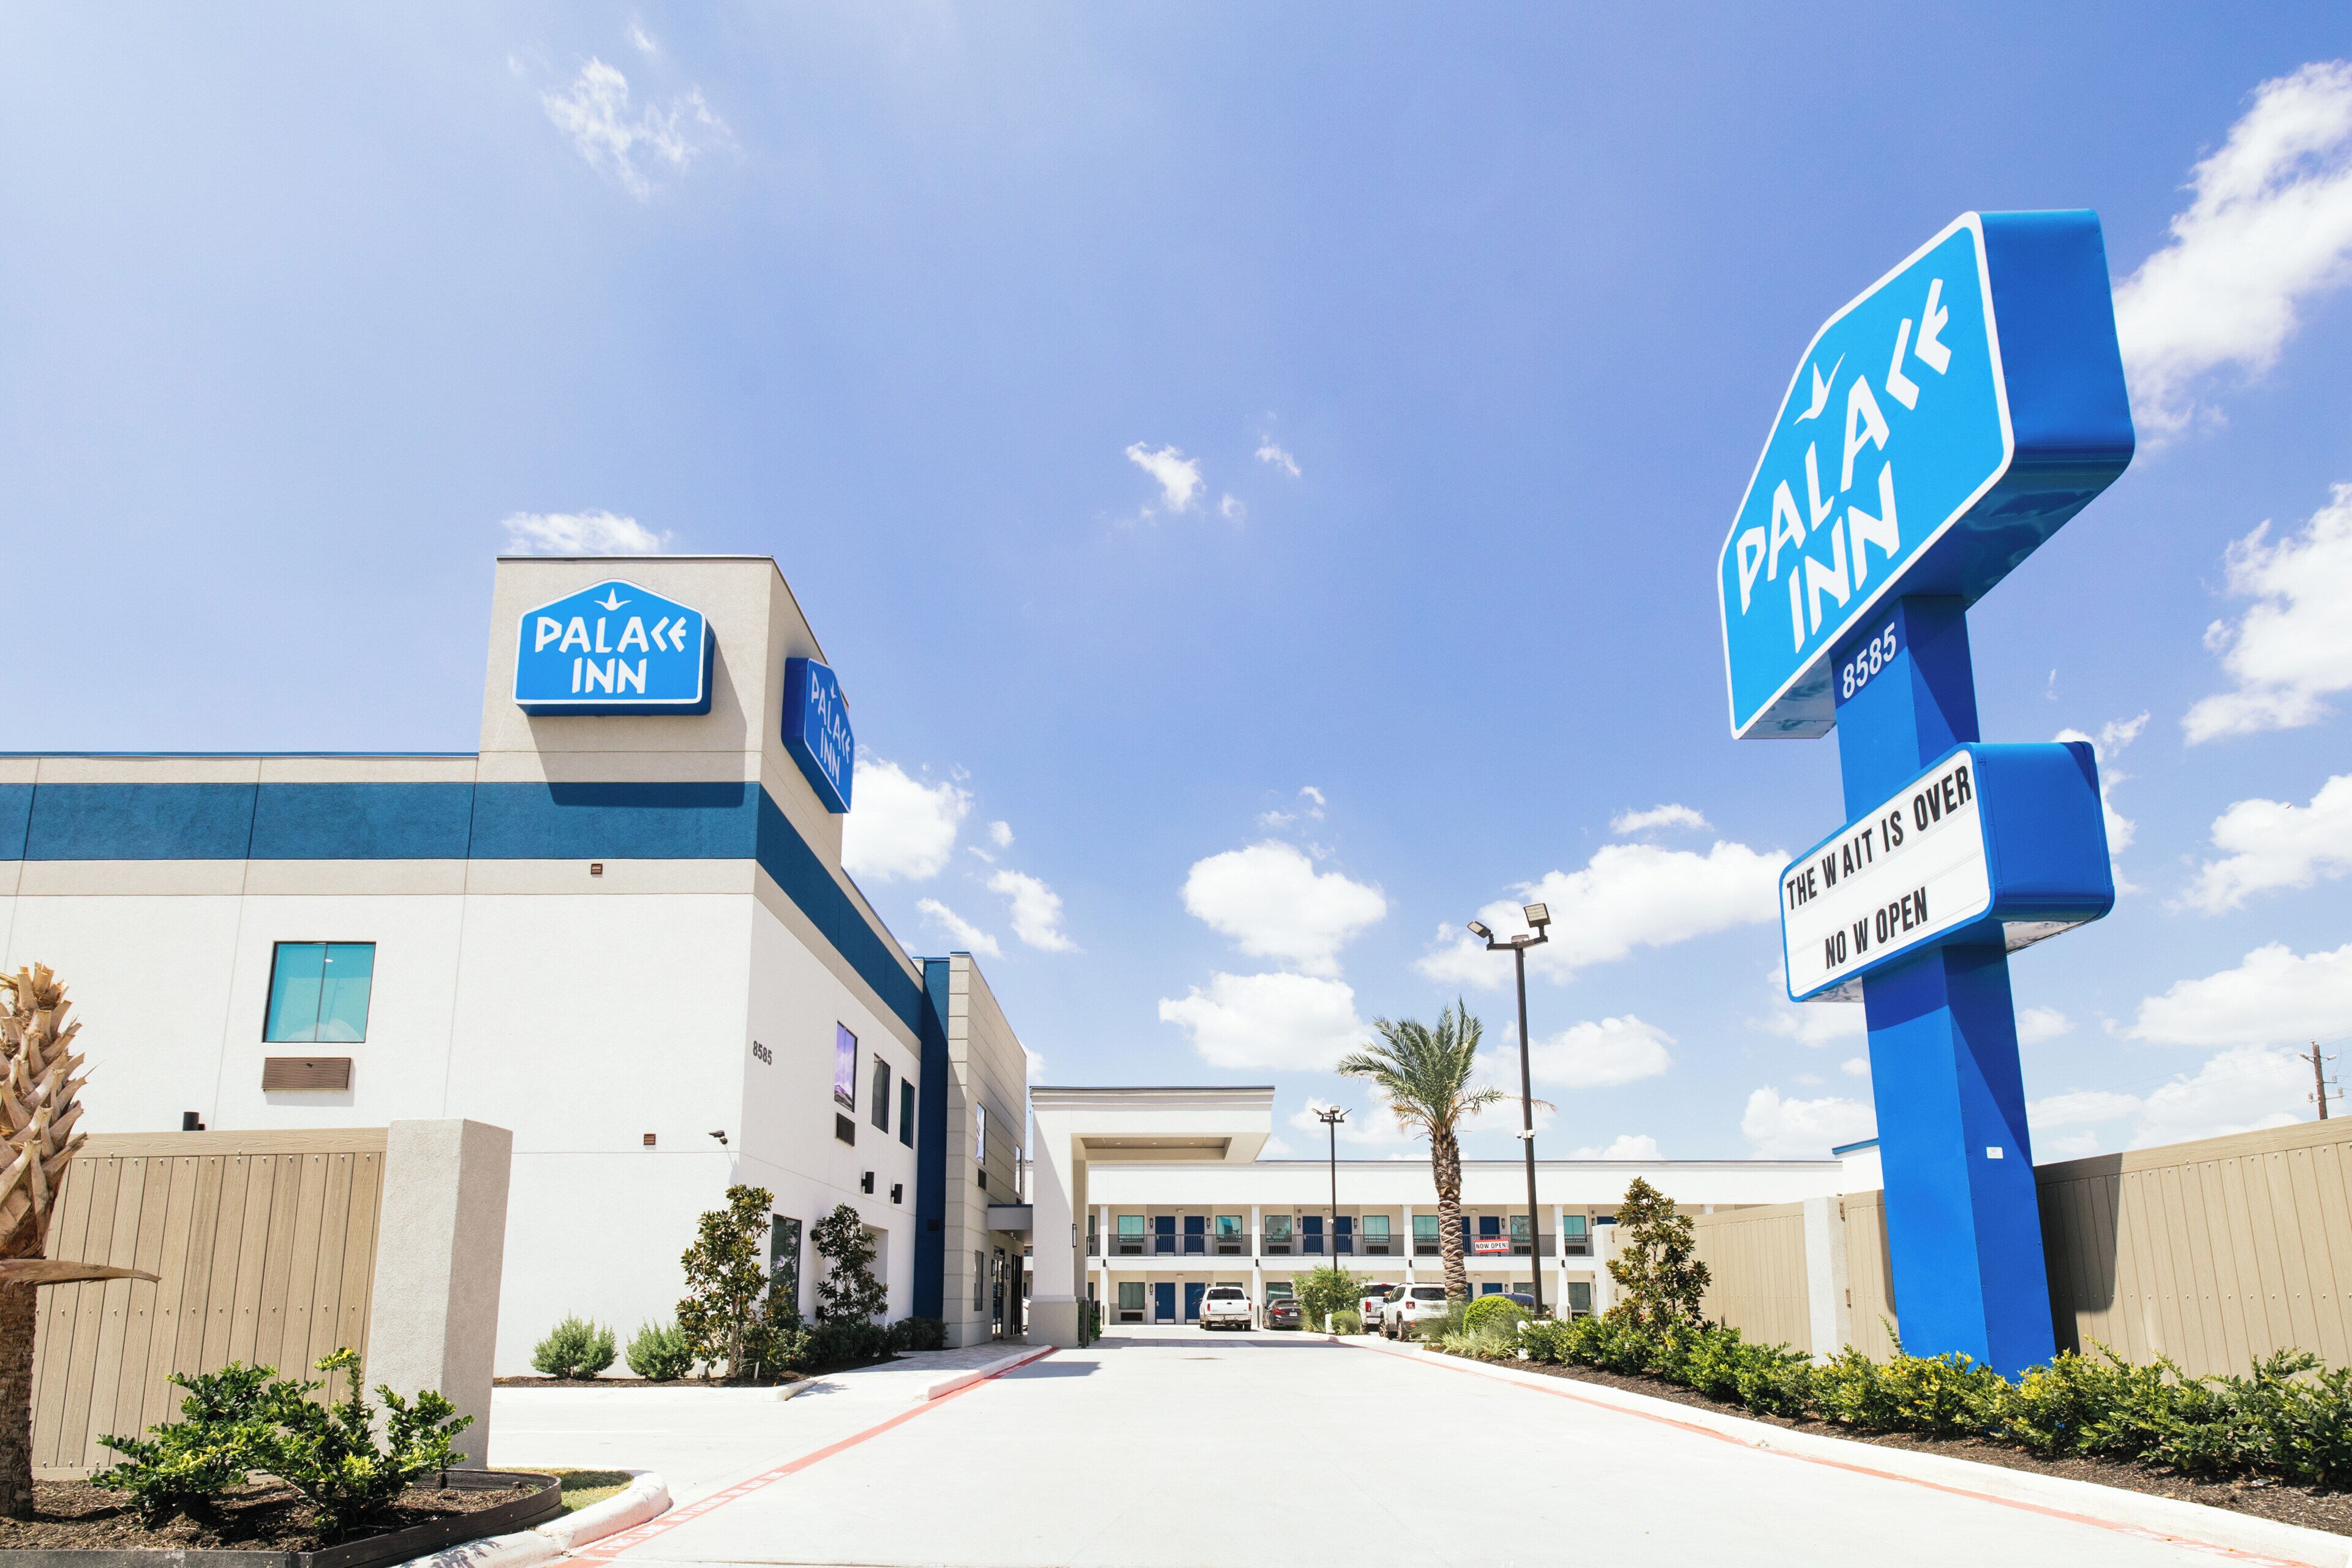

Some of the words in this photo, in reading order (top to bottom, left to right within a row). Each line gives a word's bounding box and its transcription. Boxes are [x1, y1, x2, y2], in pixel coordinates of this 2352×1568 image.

[1736, 278, 1952, 616] PALACE
[1789, 461, 1900, 654] INN
[535, 616, 687, 653] PALACE
[1843, 622, 1897, 699] 8585
[571, 657, 647, 694] INN
[811, 670, 851, 764] PALACE
[820, 728, 840, 786] INN
[1787, 867, 1817, 910] THE
[1882, 810, 1904, 853] IS
[1913, 765, 1972, 832] OVER
[1875, 886, 1928, 944] OPEN
[753, 1040, 772, 1066] 8585
